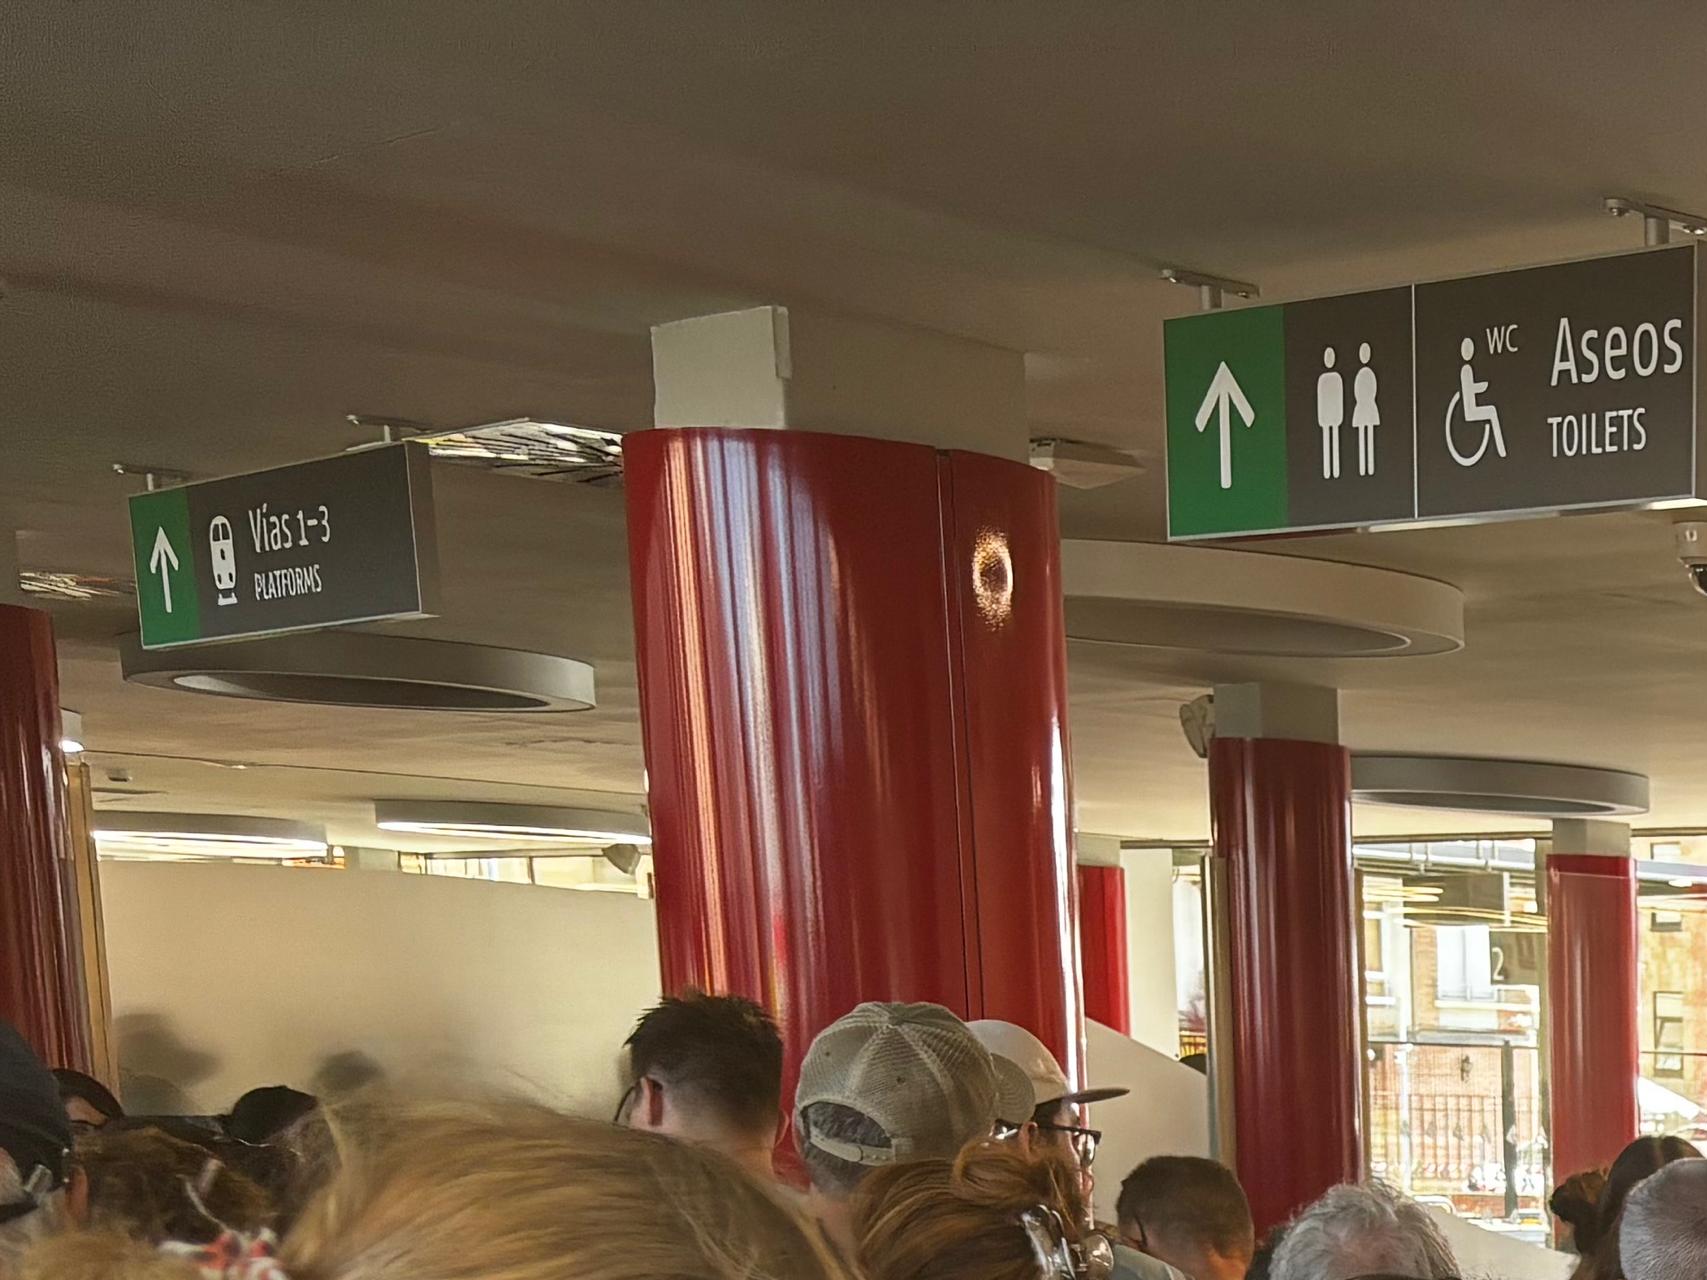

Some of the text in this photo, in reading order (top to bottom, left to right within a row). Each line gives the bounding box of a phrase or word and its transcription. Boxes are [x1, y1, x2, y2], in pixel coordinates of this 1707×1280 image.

[1485, 324, 1519, 355] WC
[1549, 316, 1684, 387] Aseos
[1546, 407, 1648, 458] TOILETS
[248, 502, 331, 553] Vías 1-3
[254, 564, 323, 601] PLATFORMS
[1491, 946, 1505, 981] 2
